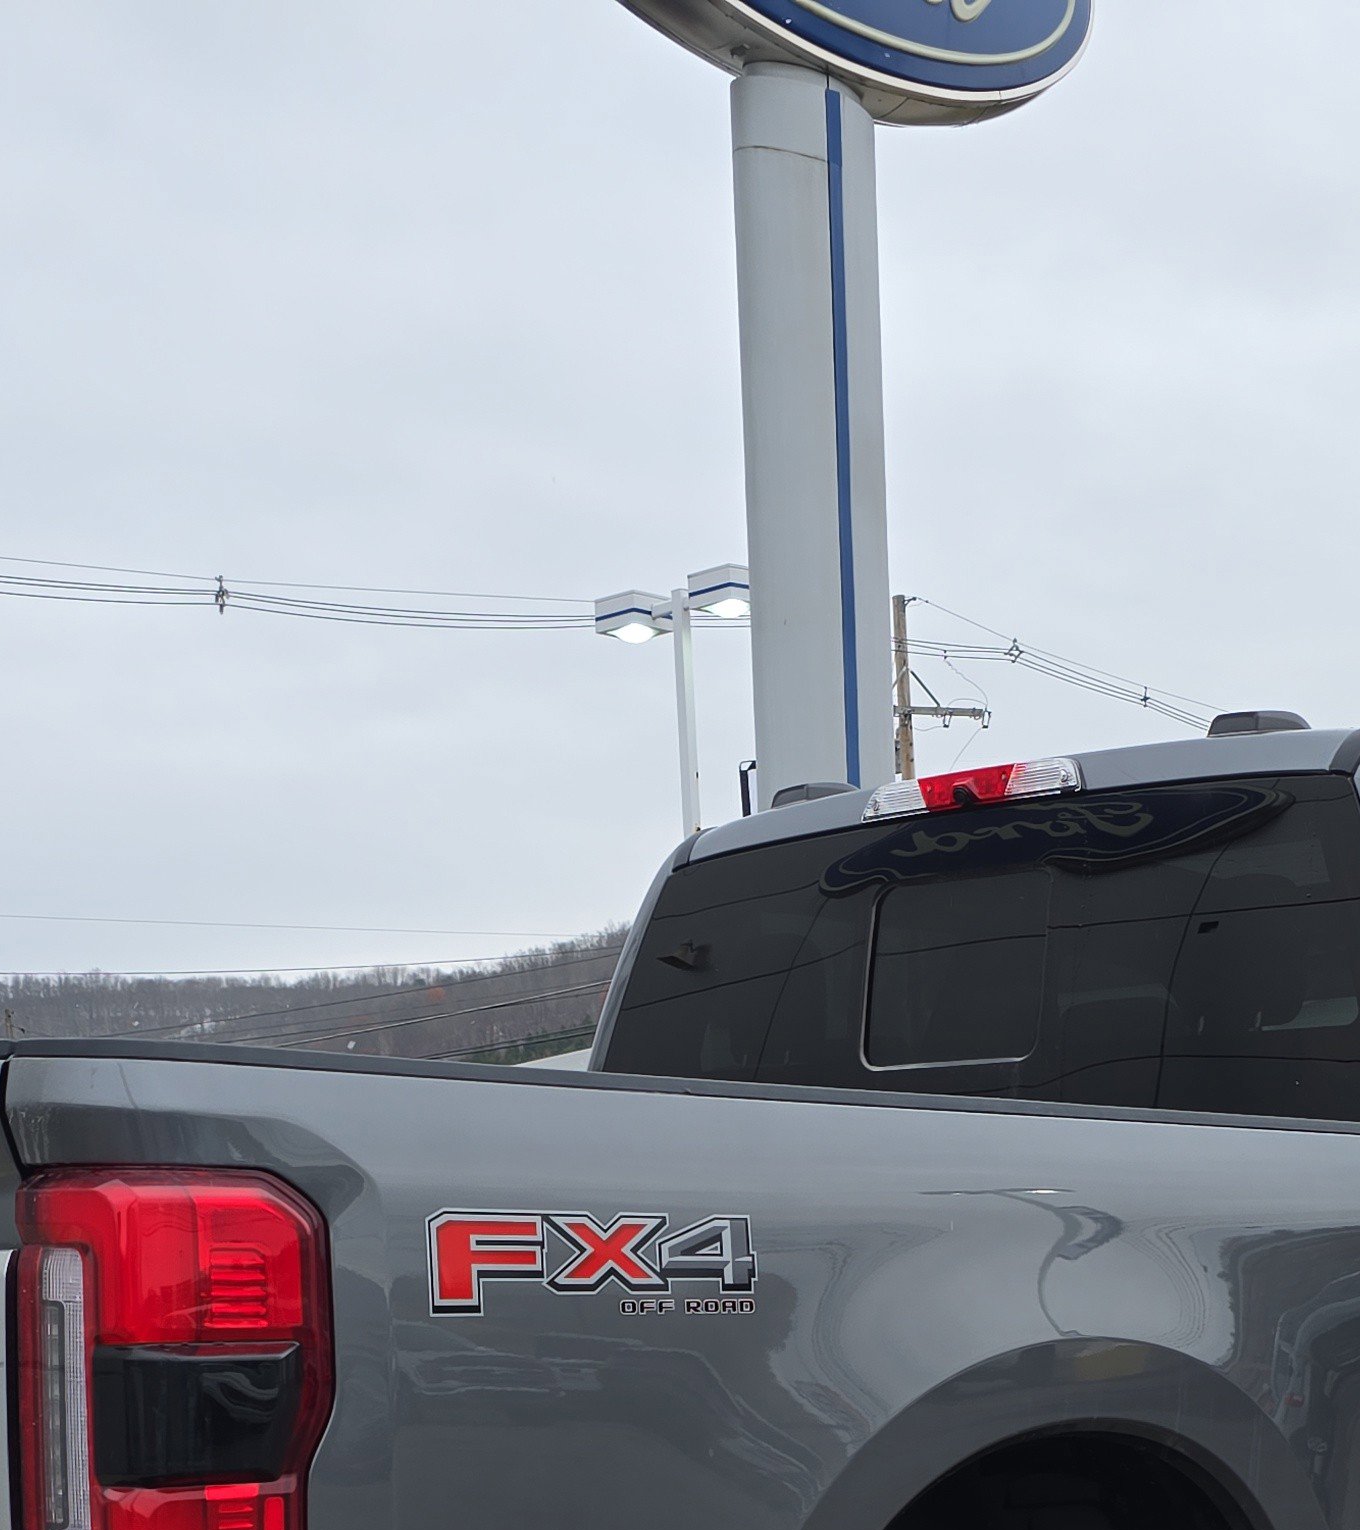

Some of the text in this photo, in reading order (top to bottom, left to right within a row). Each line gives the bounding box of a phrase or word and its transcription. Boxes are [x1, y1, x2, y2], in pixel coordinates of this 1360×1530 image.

[425, 1207, 758, 1317] FX4
[619, 1298, 756, 1316] OFF ROAD
